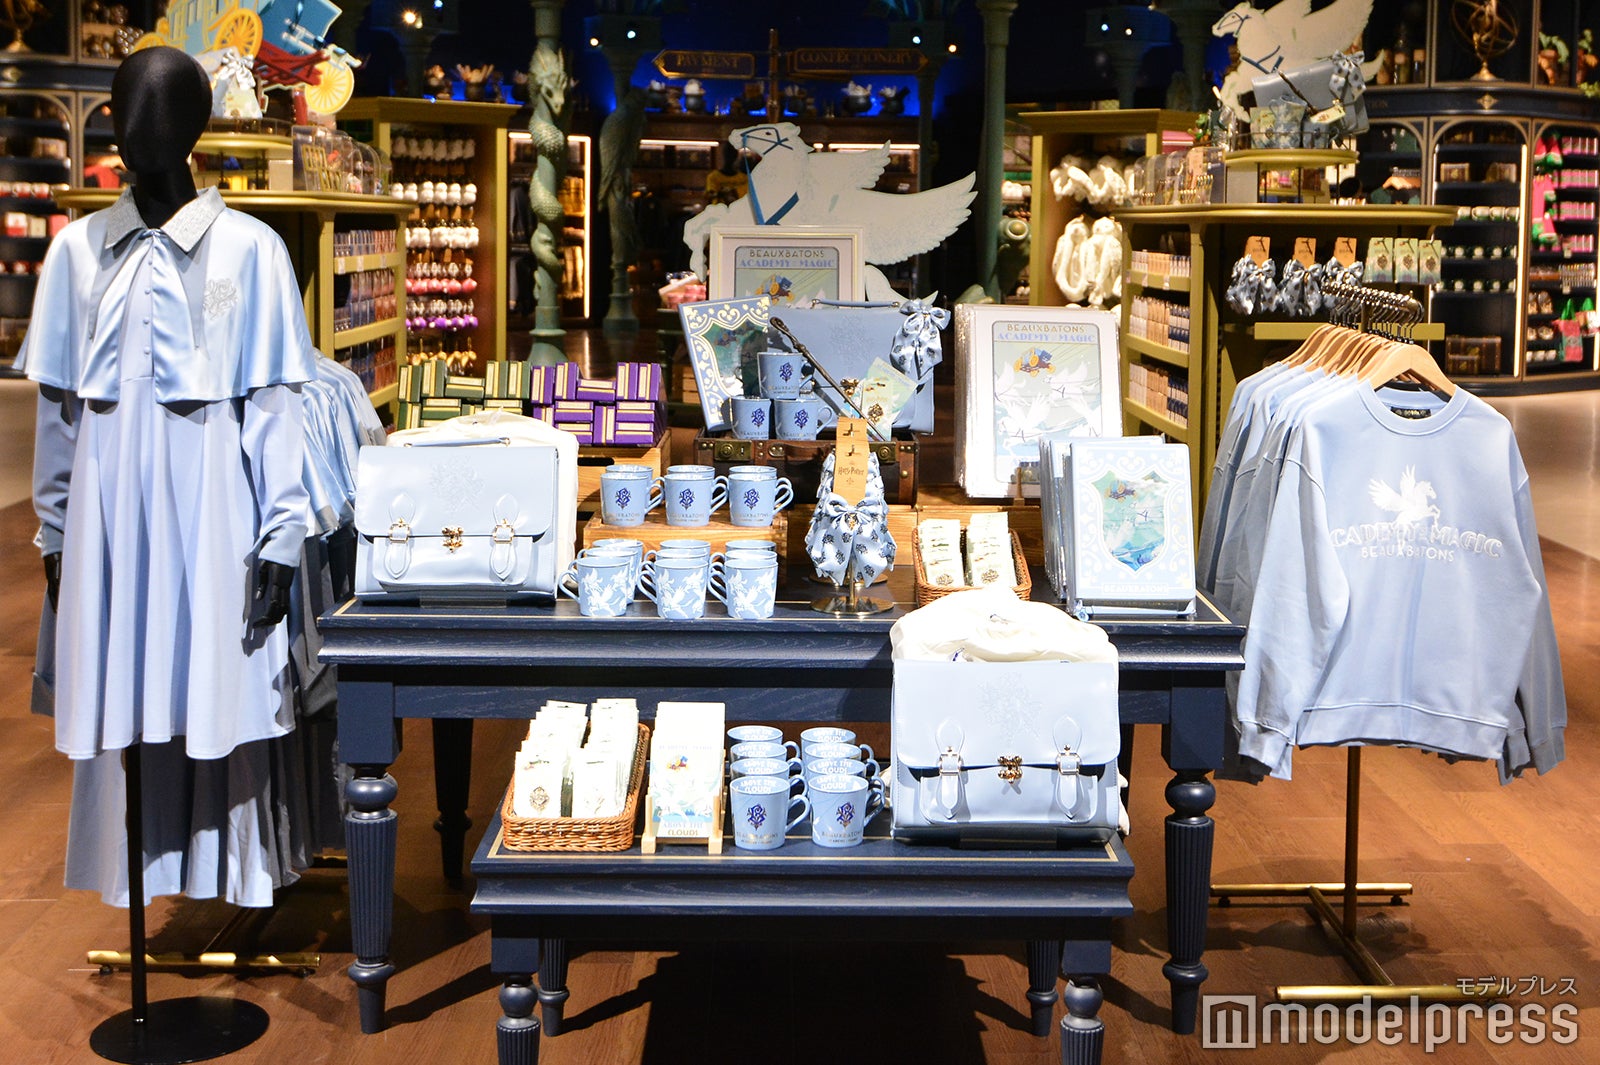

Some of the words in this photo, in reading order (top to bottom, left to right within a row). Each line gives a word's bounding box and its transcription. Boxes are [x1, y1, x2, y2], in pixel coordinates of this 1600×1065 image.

[676, 54, 739, 68] PAYMENT
[800, 50, 913, 64] CONFECTIONERY
[749, 249, 825, 258] BEAUXBATONS
[740, 259, 791, 268] ACADEMY
[800, 259, 833, 268] MAGIC
[1007, 324, 1085, 333] BEAUXBATONS
[998, 333, 1050, 341] ACADEMY
[1059, 334, 1095, 343] MAGIC
[1329, 521, 1422, 547] CADEMY
[1430, 524, 1503, 558] MAGIC
